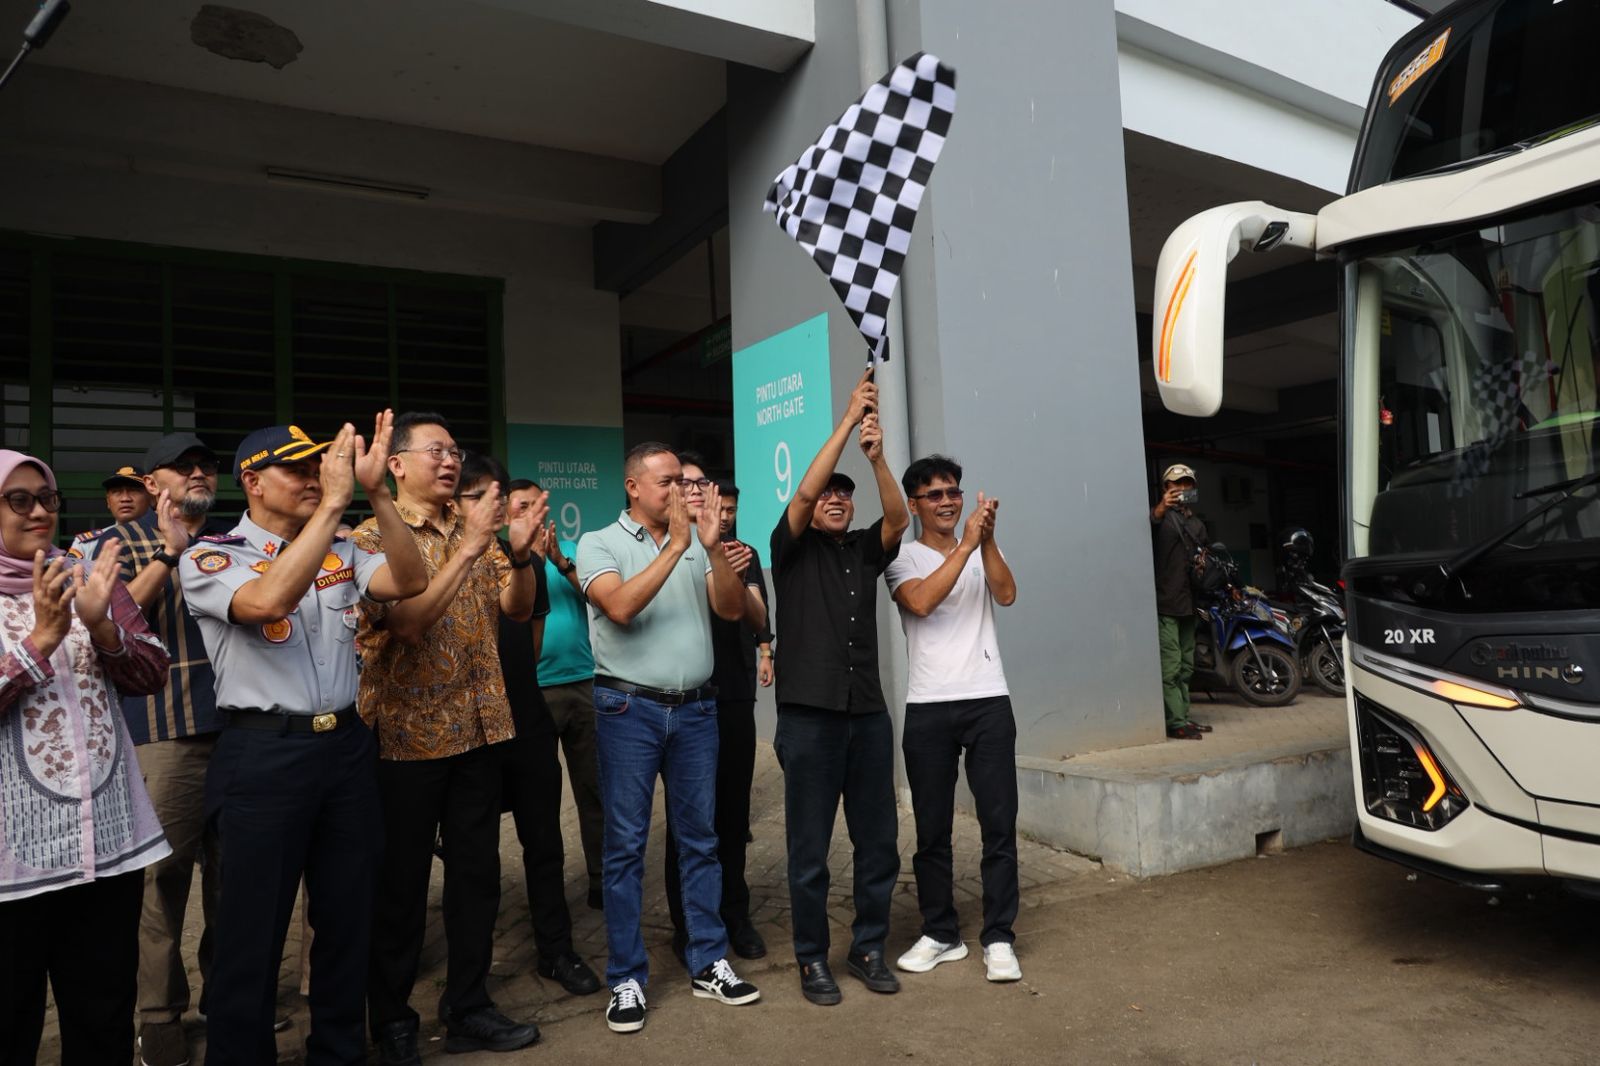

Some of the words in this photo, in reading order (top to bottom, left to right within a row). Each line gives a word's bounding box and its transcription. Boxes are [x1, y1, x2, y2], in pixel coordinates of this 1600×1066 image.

[756, 381, 777, 404] PINTU
[778, 371, 804, 397] UTARA
[757, 402, 782, 427] NORTH
[783, 395, 805, 418] GATE
[538, 461, 565, 474] PINTU
[566, 461, 597, 474] UTARA
[774, 441, 792, 503] 9
[540, 477, 571, 489] NORTH
[573, 478, 598, 490] GATE
[560, 502, 581, 541] 9
[1384, 629, 1405, 645] 20
[1409, 628, 1436, 645] XR
[1497, 664, 1583, 682] HIN
